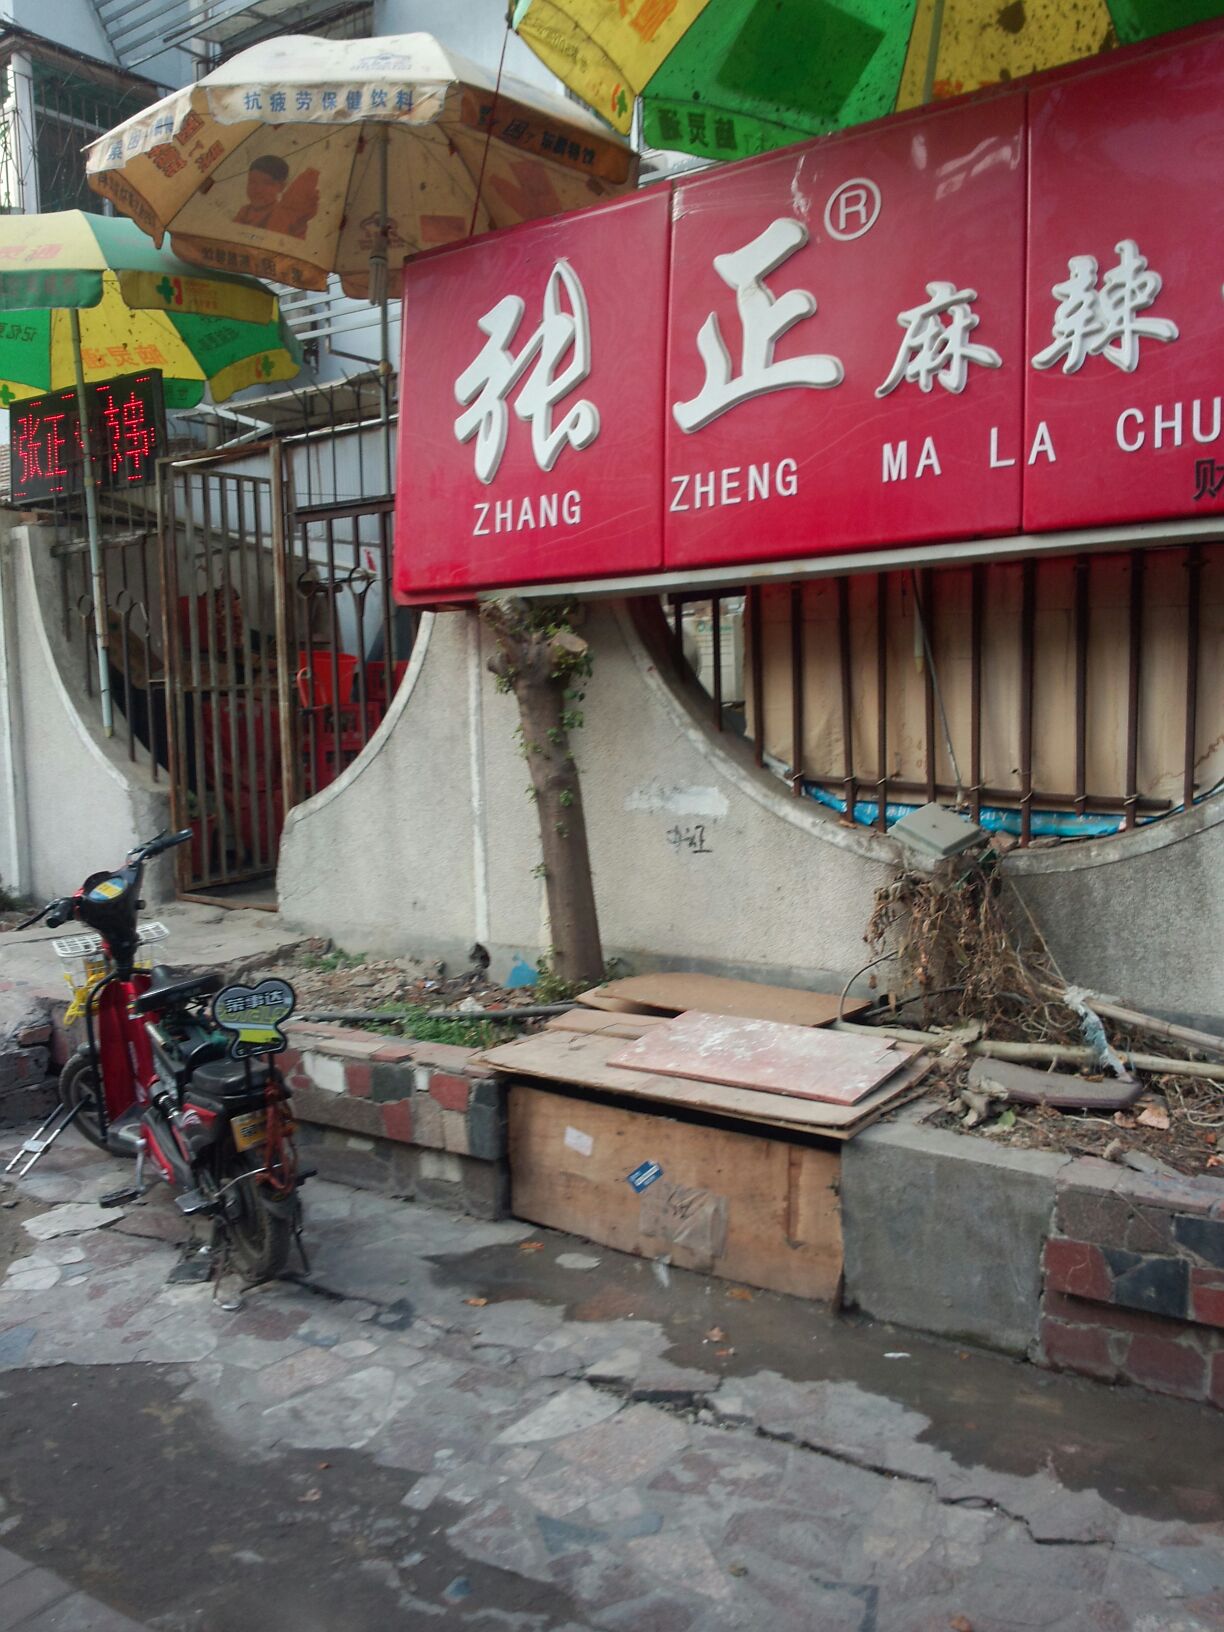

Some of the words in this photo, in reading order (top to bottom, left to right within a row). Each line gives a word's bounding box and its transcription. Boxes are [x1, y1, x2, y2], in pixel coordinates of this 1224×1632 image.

[243, 88, 414, 113] 抗疲劳保健饮料
[472, 489, 581, 537] ZHANG
[668, 456, 798, 513] ZHENG
[882, 435, 942, 483] MA
[989, 421, 1057, 469] LA
[1115, 396, 1222, 452] CHU
